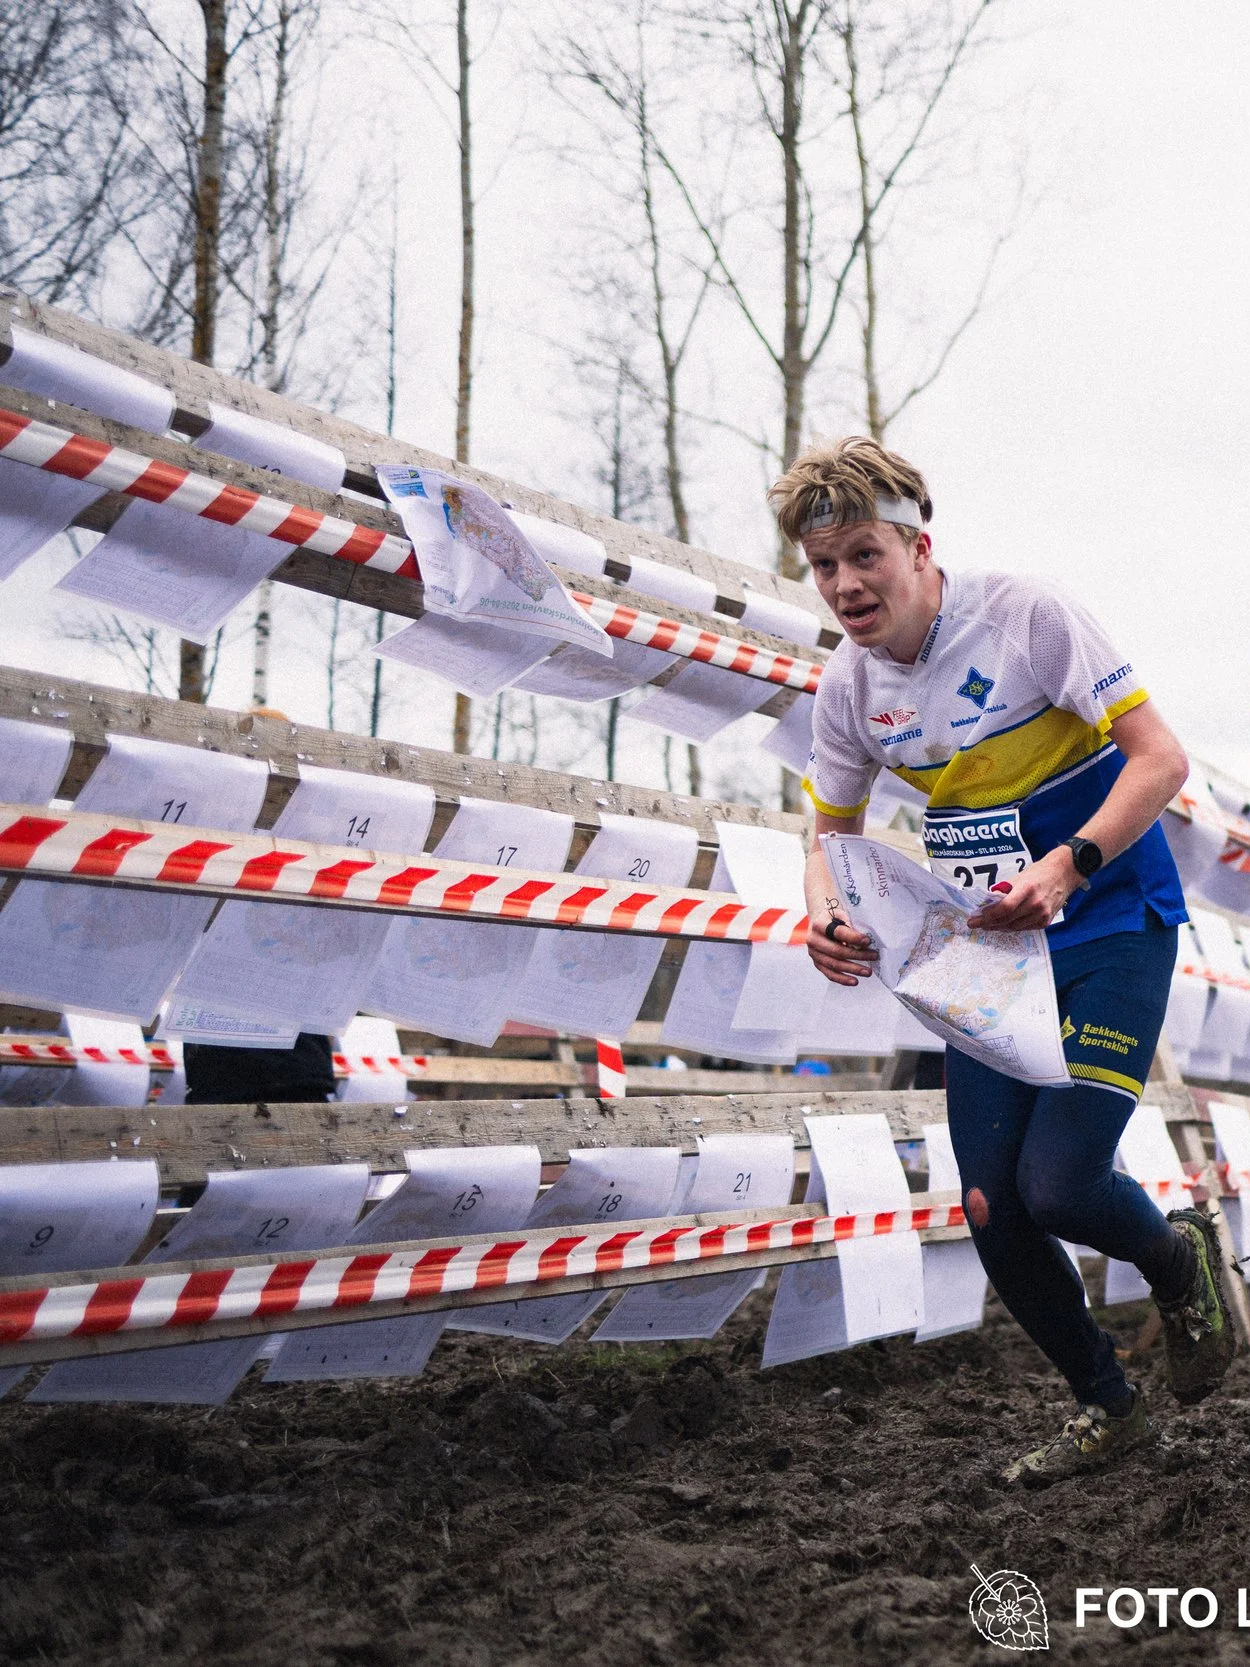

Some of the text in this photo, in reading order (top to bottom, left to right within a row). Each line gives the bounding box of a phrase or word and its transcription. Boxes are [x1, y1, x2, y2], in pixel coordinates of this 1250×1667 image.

[920, 614, 943, 664] noname
[161, 799, 188, 824] 11
[347, 815, 372, 840] 14
[496, 845, 518, 867] 17
[628, 858, 651, 878] 20
[838, 843, 858, 894] Kolmården
[869, 846, 891, 899] Skinnarbo
[953, 862, 999, 893] 27
[1078, 1034, 1130, 1056] Sportsklub
[1082, 1023, 1139, 1047] Bækkelagets
[732, 1172, 753, 1193] 21
[451, 1190, 479, 1212] 15
[597, 1193, 623, 1213] 18
[29, 1225, 55, 1249] 9
[256, 1217, 290, 1239] 12
